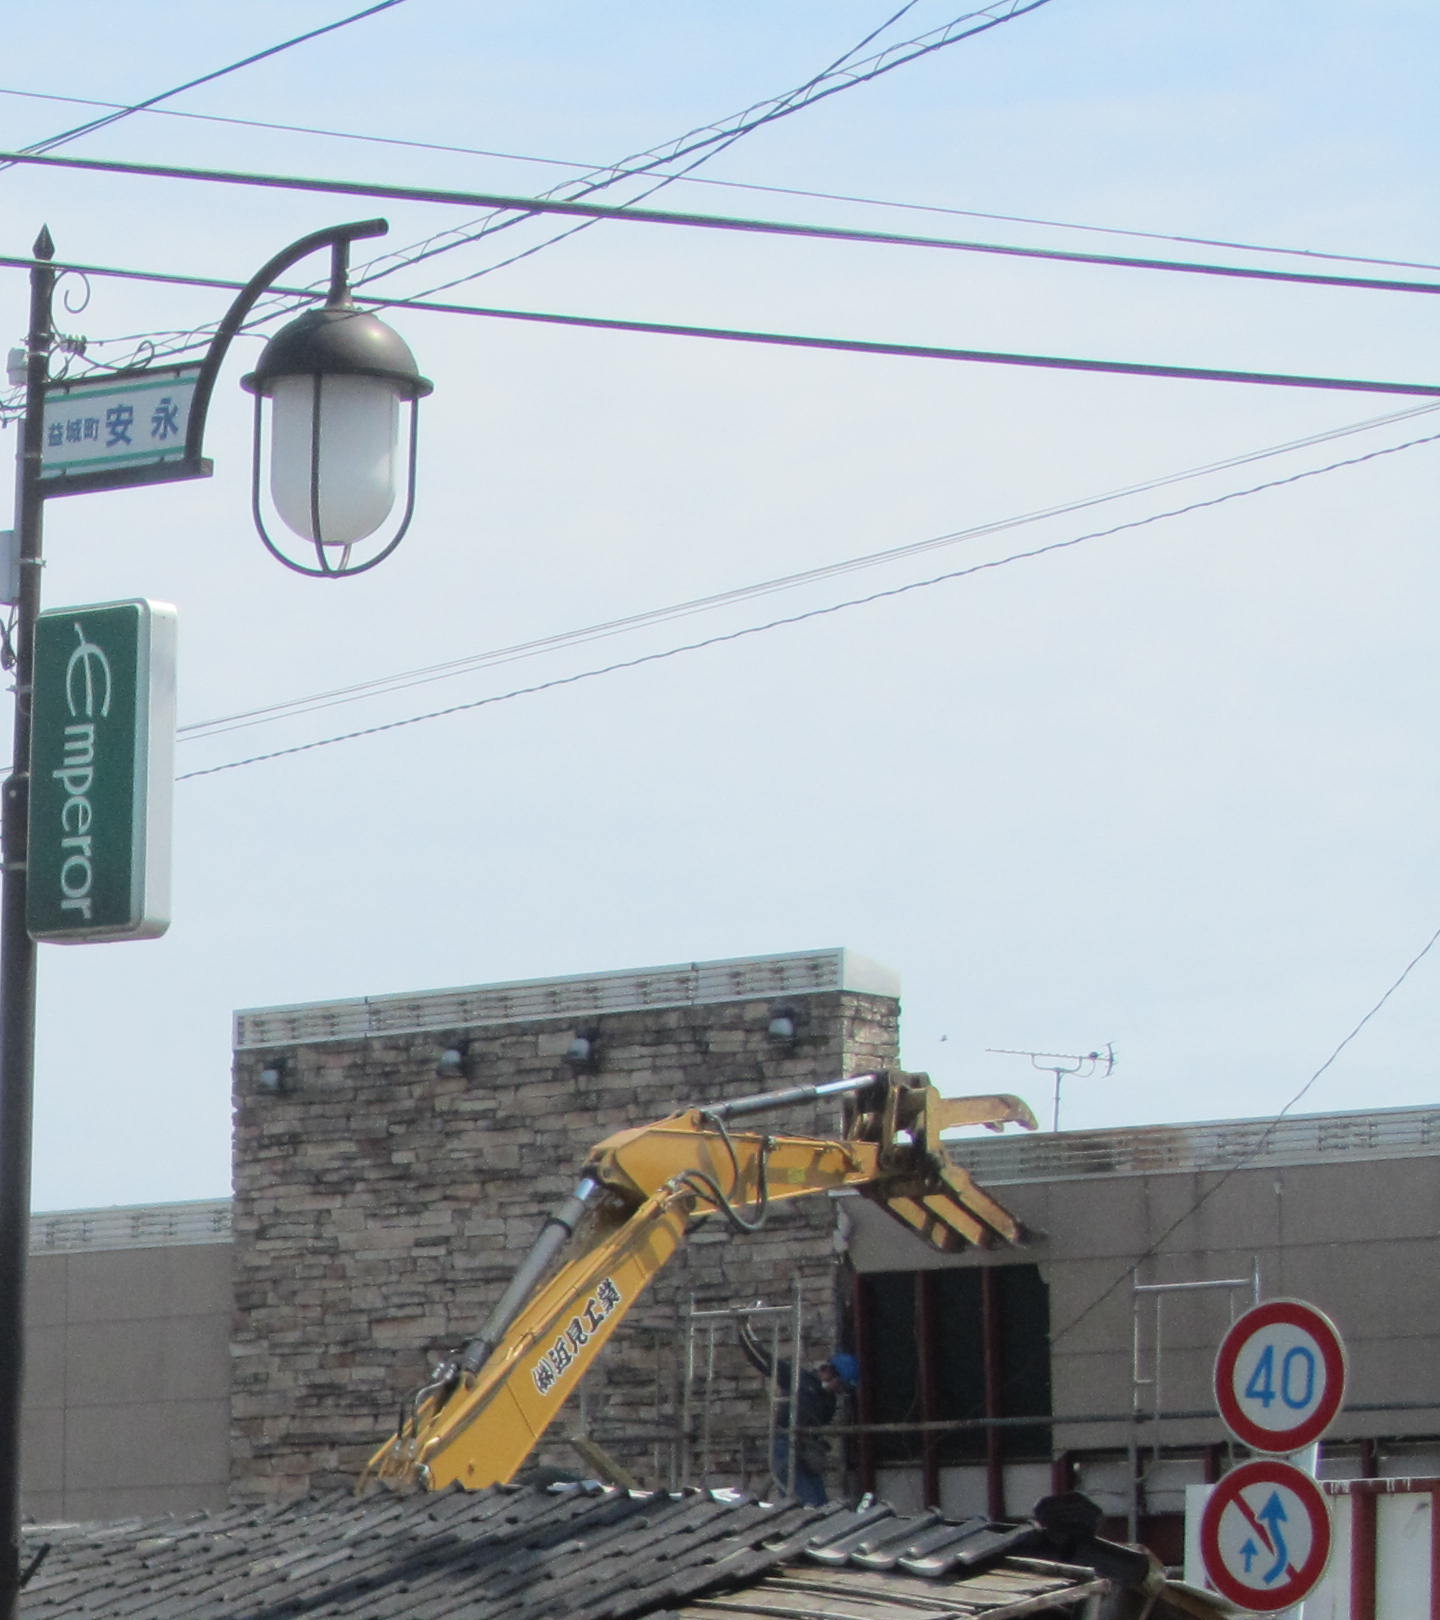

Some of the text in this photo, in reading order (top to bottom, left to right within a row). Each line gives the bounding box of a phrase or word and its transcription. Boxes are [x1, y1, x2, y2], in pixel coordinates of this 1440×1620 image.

[48, 396, 179, 448] 益城町 安永
[52, 621, 112, 920] Emperor
[1244, 1343, 1316, 1409] 40
